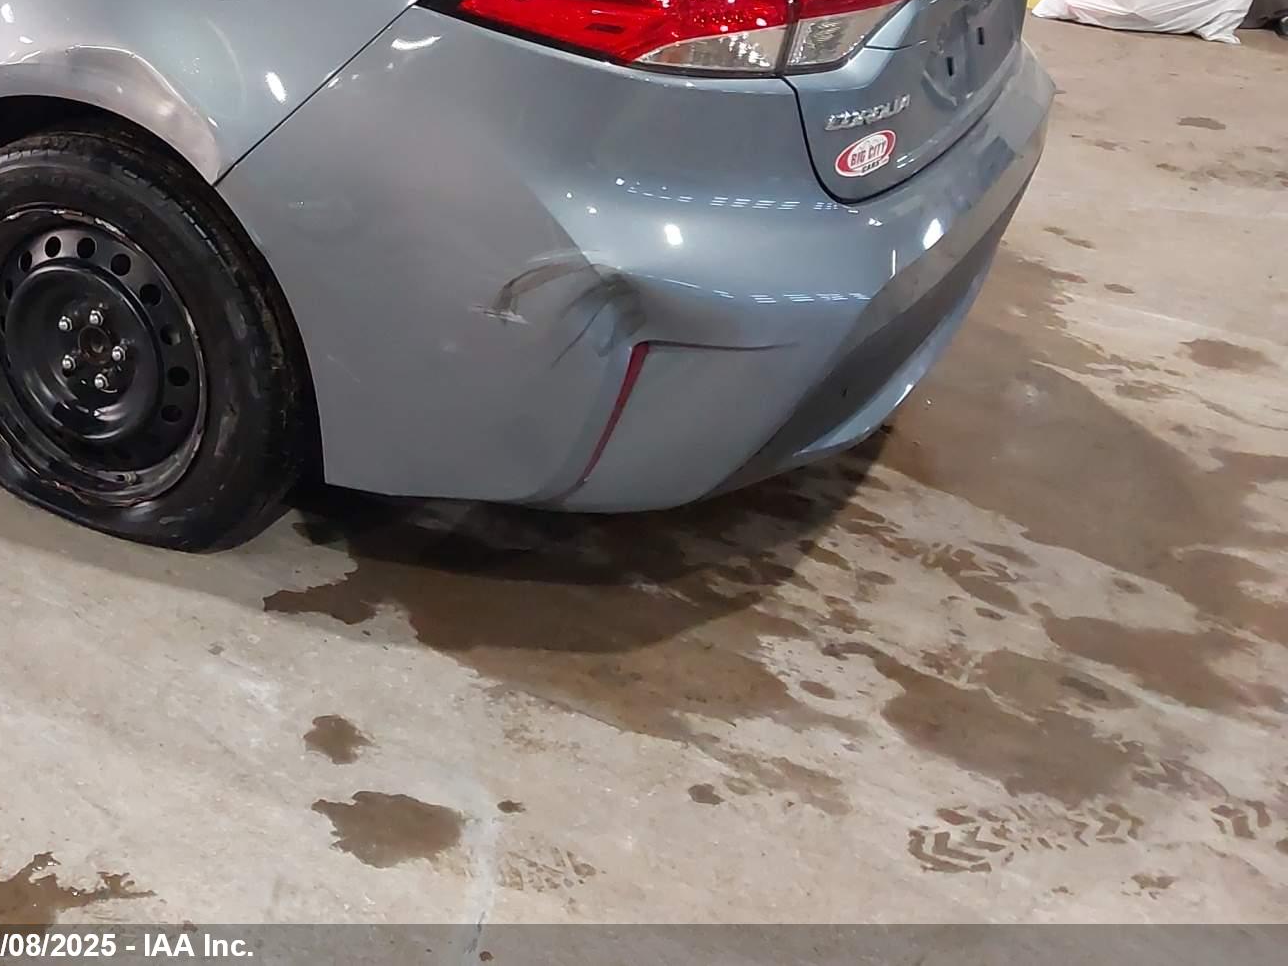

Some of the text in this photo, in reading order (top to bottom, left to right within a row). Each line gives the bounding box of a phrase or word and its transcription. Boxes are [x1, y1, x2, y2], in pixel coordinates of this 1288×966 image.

[850, 140, 887, 166] BIG CITY
[862, 160, 880, 173] CARS
